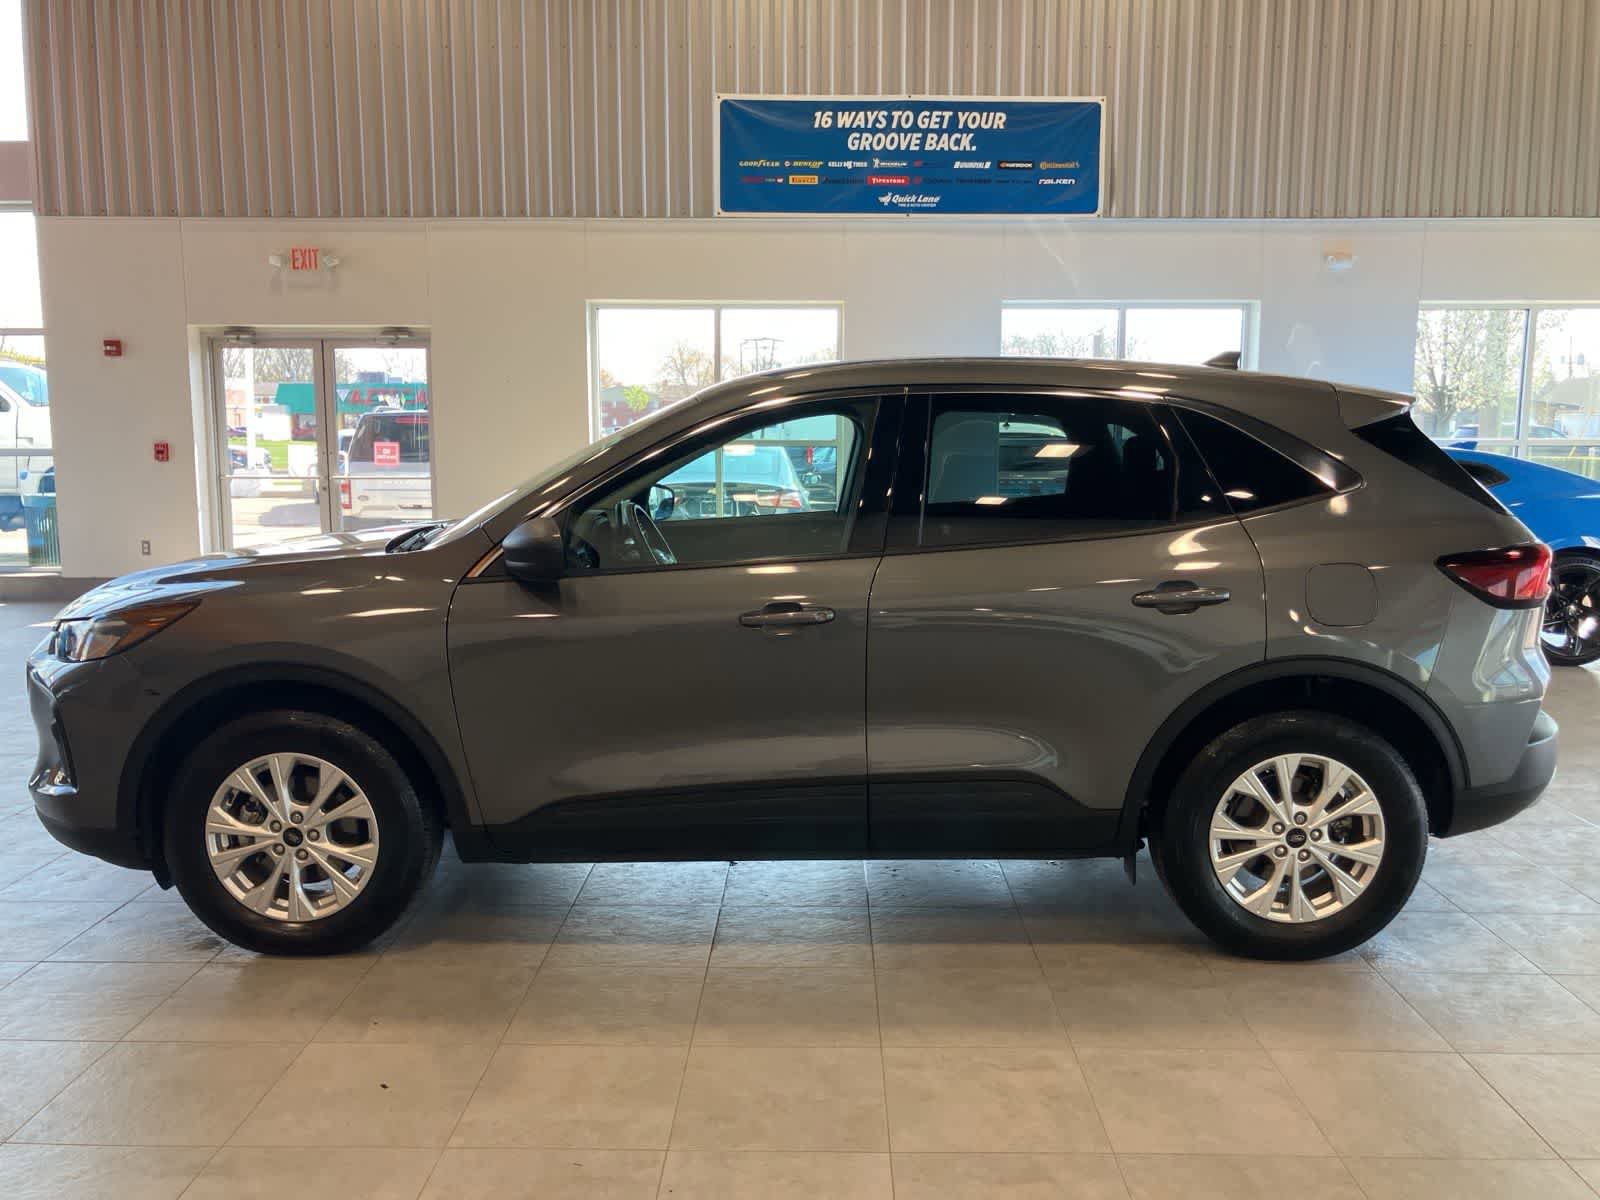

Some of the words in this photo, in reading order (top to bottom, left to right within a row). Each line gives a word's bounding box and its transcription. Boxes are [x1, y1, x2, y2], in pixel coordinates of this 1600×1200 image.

[814, 111, 833, 129] 16
[837, 111, 888, 129] WAYS
[891, 111, 914, 129] TO
[917, 111, 953, 129] GET
[957, 112, 1007, 130] YOUR
[847, 132, 922, 151] GROOVE
[924, 132, 977, 152] BACK.
[738, 159, 780, 168] GOODYEAR
[891, 194, 917, 204] Quick
[917, 194, 941, 203] Lane
[291, 247, 320, 271] EXIT
